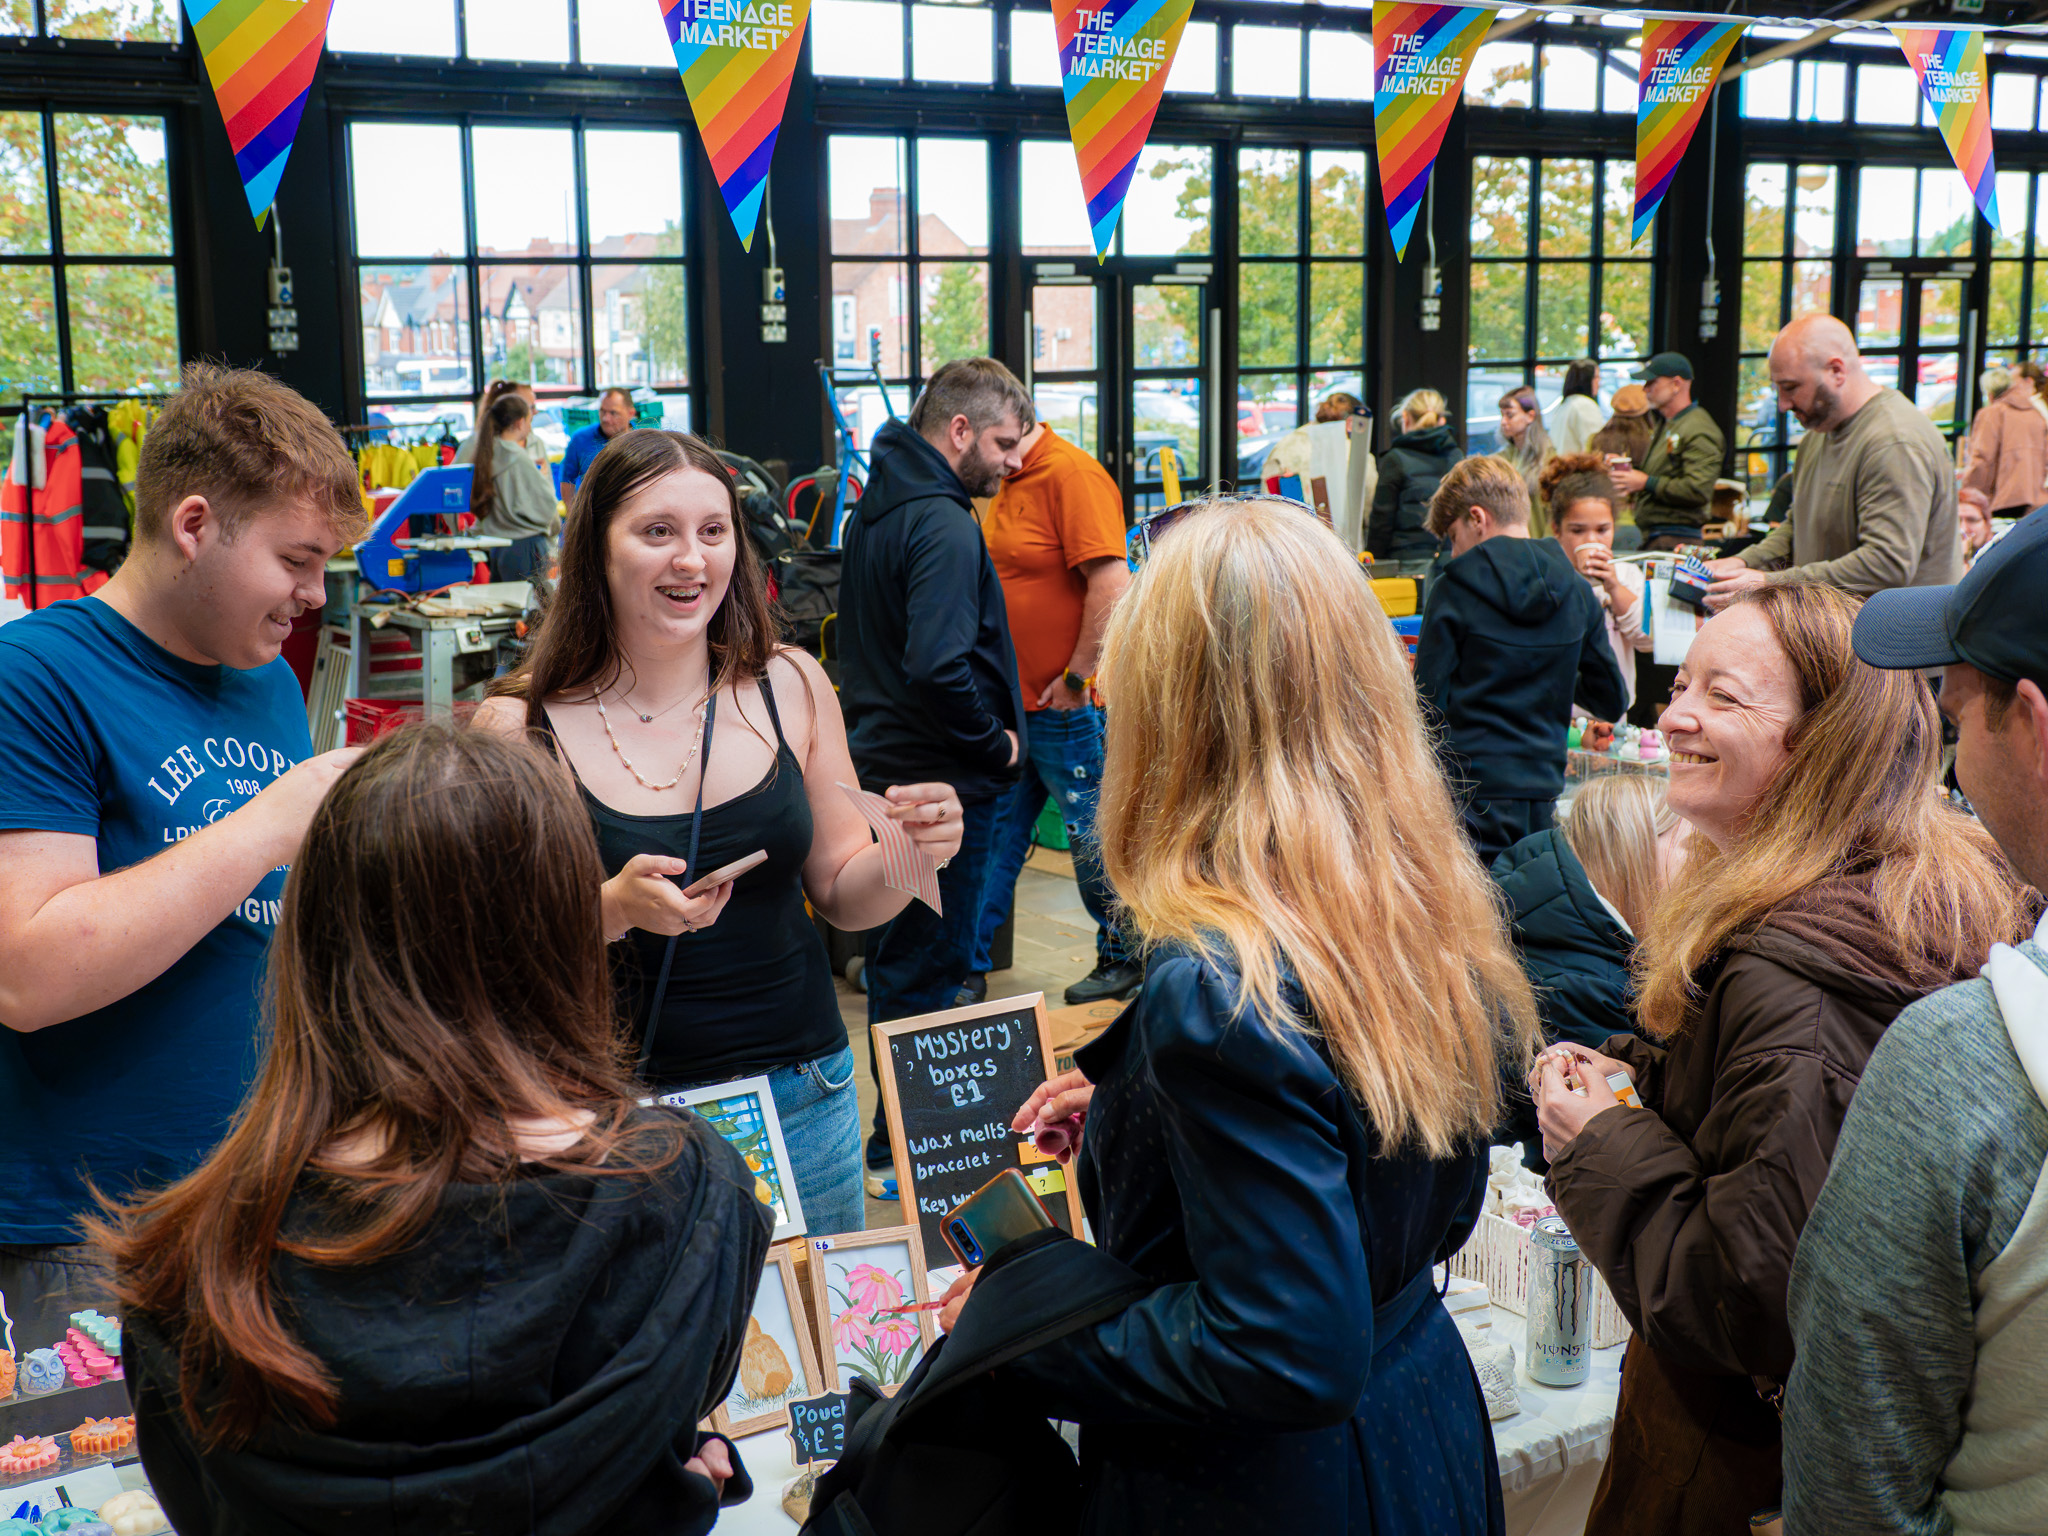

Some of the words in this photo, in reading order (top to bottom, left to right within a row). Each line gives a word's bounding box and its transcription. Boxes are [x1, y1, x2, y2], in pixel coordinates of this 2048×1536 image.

[683, 0, 793, 27] TEENAGE
[1076, 9, 1114, 32] THE
[1073, 32, 1166, 60] TEENAGE
[1392, 33, 1424, 53] THE
[1387, 54, 1463, 76] TEENAGE
[1656, 48, 1683, 65] THE
[1918, 53, 1944, 70] THE
[1651, 66, 1713, 84] TEENAGE
[1923, 70, 1982, 87] TEENAGE
[148, 744, 205, 807] LEE
[204, 737, 297, 778] COOP
[226, 778, 261, 796] 1908
[914, 1022, 1011, 1061] Mystery
[928, 1058, 998, 1087] boxes
[950, 1079, 986, 1108] £1
[908, 1133, 953, 1155] Wax
[916, 1151, 990, 1181] bracelet
[920, 1196, 949, 1217] Key
